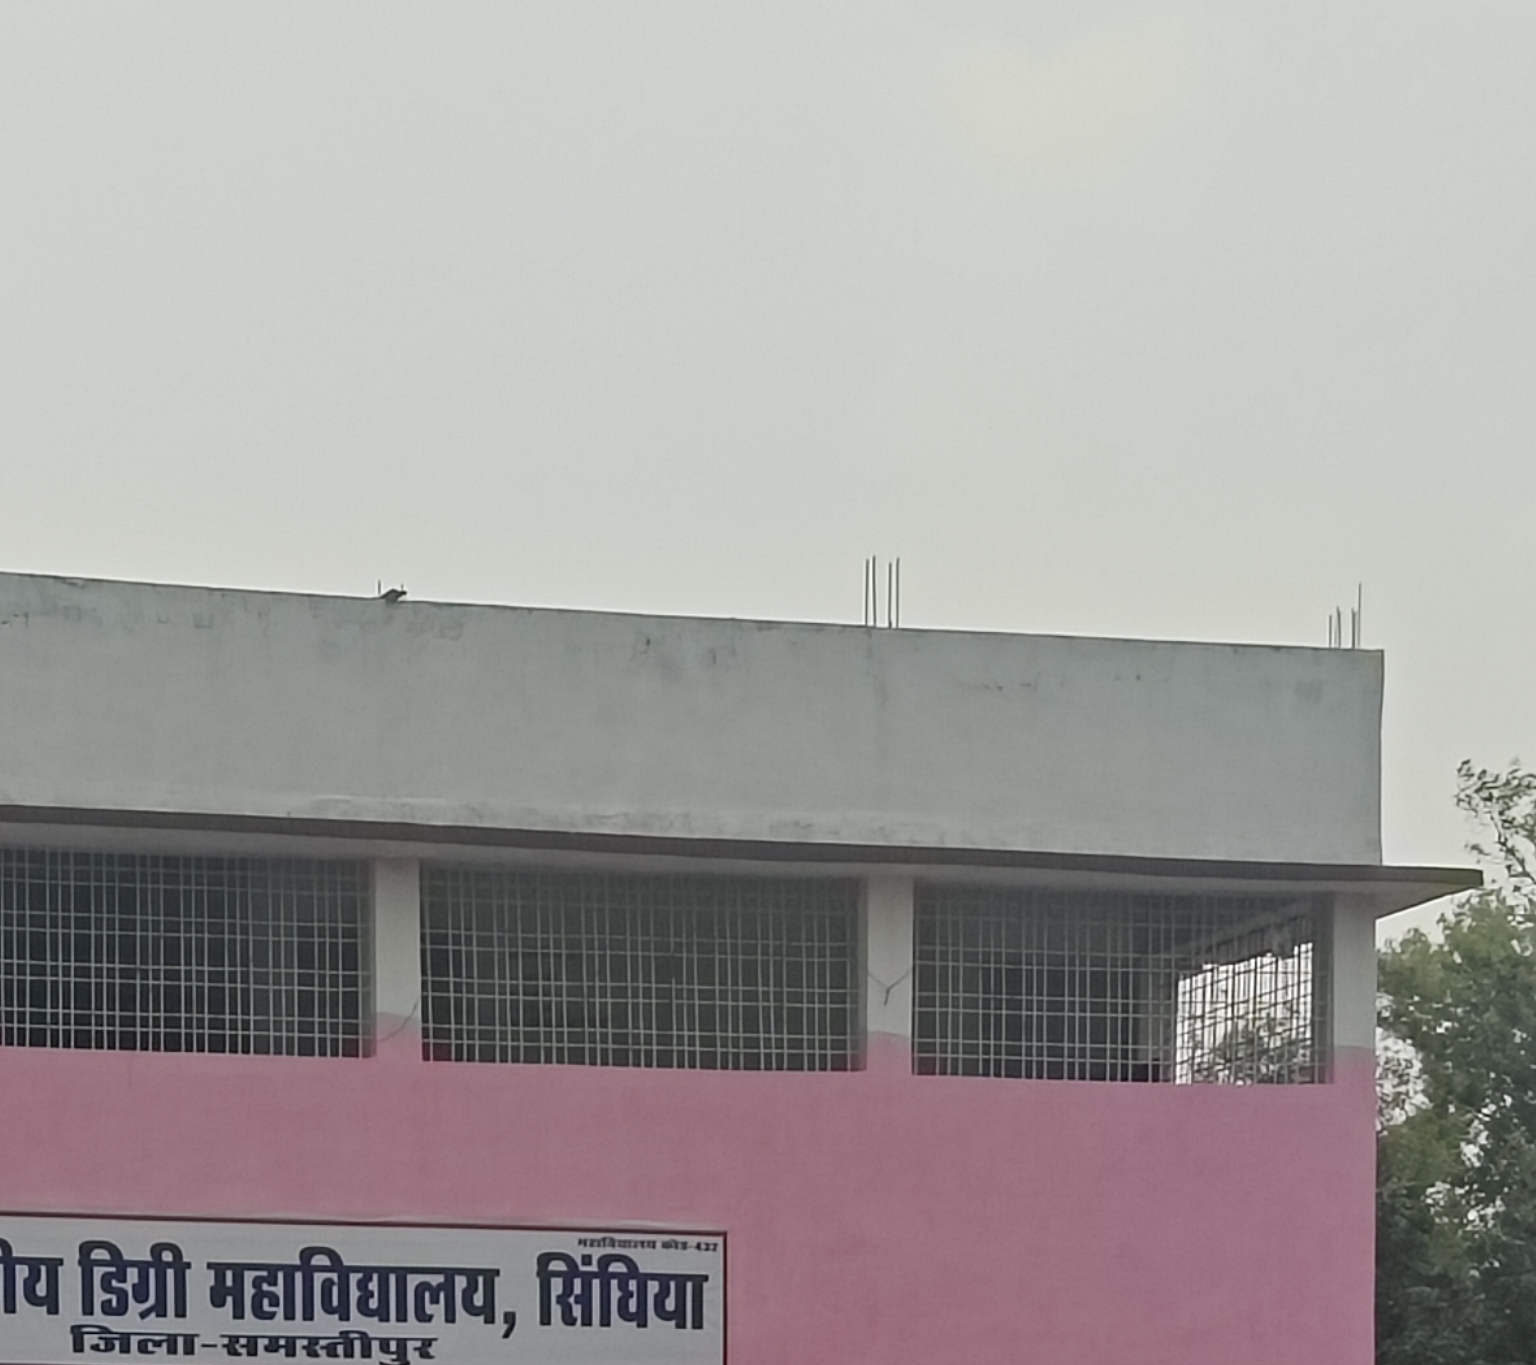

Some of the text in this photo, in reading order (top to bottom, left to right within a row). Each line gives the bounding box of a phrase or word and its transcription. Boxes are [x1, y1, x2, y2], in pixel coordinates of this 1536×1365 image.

[78, 1239, 192, 1321] डिग्री
[206, 1245, 518, 1339] महाविद्यालय,
[536, 1251, 710, 1330] सिंघिया
